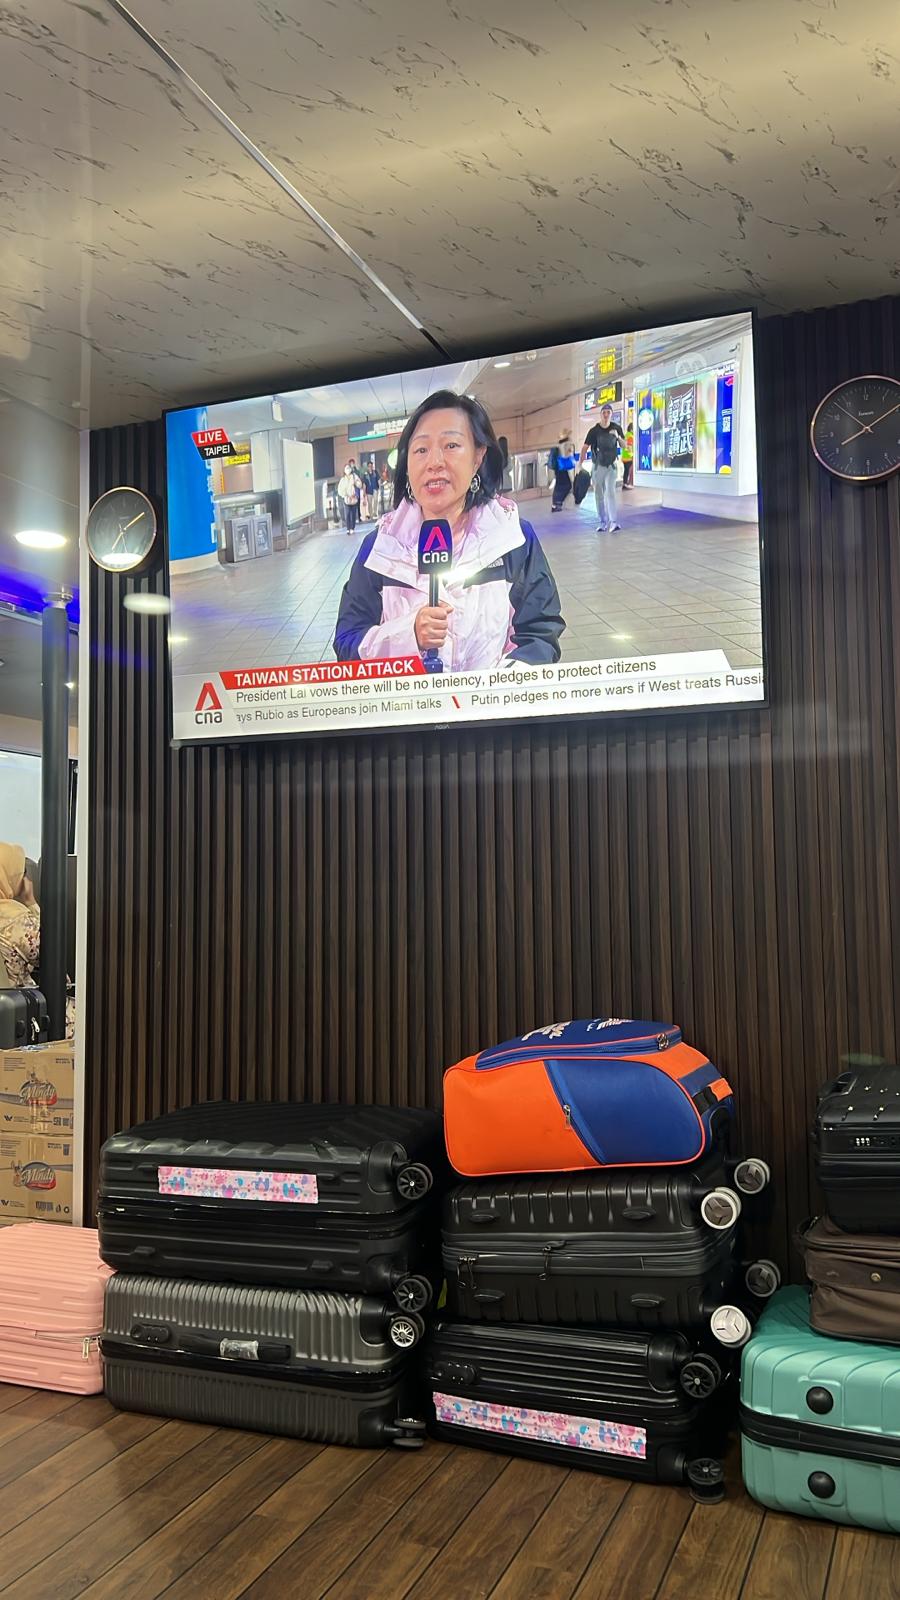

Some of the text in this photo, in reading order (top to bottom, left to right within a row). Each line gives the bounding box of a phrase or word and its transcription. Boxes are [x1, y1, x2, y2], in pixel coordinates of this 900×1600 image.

[197, 430, 222, 444] LIVE
[204, 445, 231, 457] TAIPEI
[421, 551, 449, 564] cna
[234, 659, 415, 687] TAIWAN STATION ATTACK
[236, 659, 657, 703] President Lai vows there will be no leniency, pledges to protect citizens
[471, 692, 500, 705] Putin
[503, 691, 549, 706] pledges
[552, 689, 567, 700] no
[570, 687, 602, 699] more
[605, 684, 634, 696] wars
[637, 681, 646, 694] if
[648, 680, 681, 692] West
[685, 677, 721, 690] treats
[195, 711, 223, 724] cna
[255, 708, 284, 721] Rubio
[287, 709, 299, 719] as
[302, 704, 357, 720] Europeans
[359, 702, 378, 716] join
[381, 699, 414, 712] Miami
[416, 698, 442, 710] talks
